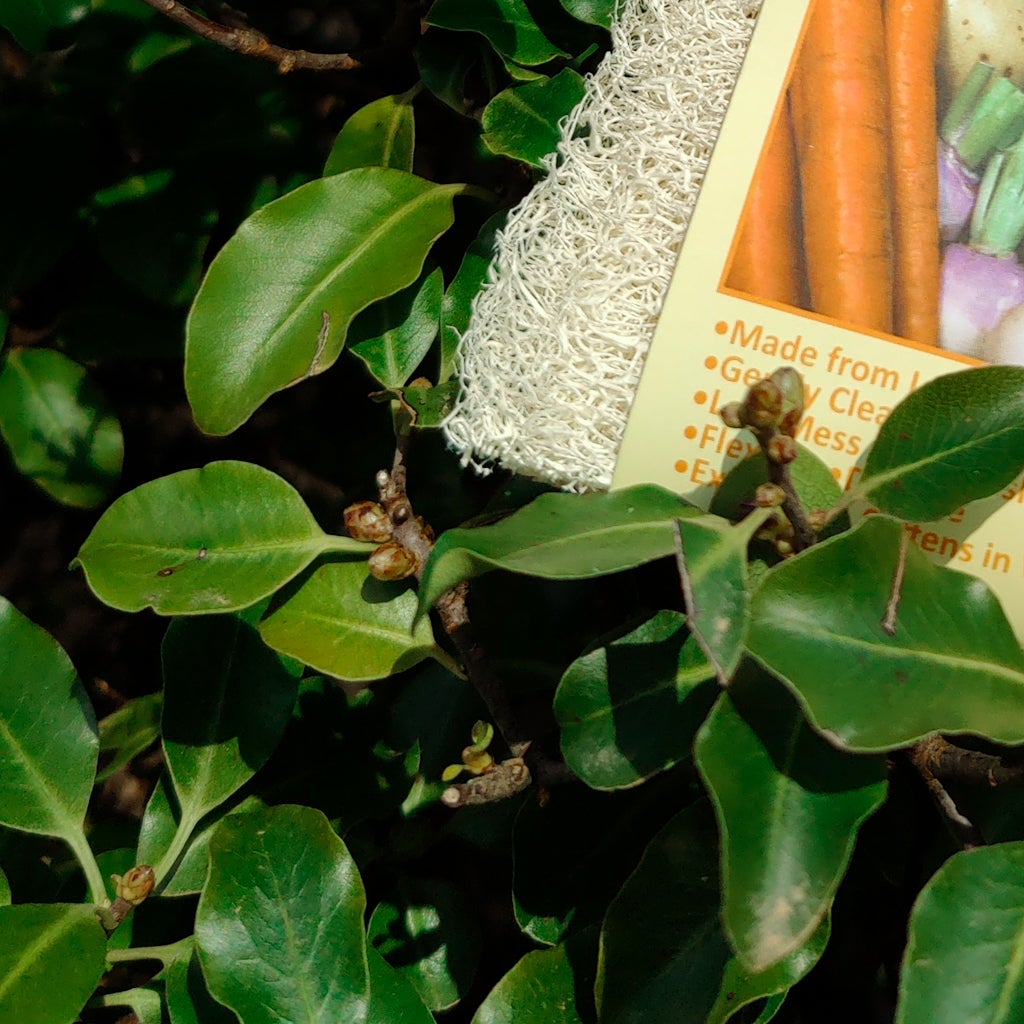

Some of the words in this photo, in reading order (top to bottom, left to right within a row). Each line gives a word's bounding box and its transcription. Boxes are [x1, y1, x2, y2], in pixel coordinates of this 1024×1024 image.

[729, 319, 819, 368] Made
[827, 345, 901, 391] from
[829, 385, 894, 427] Clea
[903, 523, 974, 564] tens
[982, 541, 1012, 574] in
